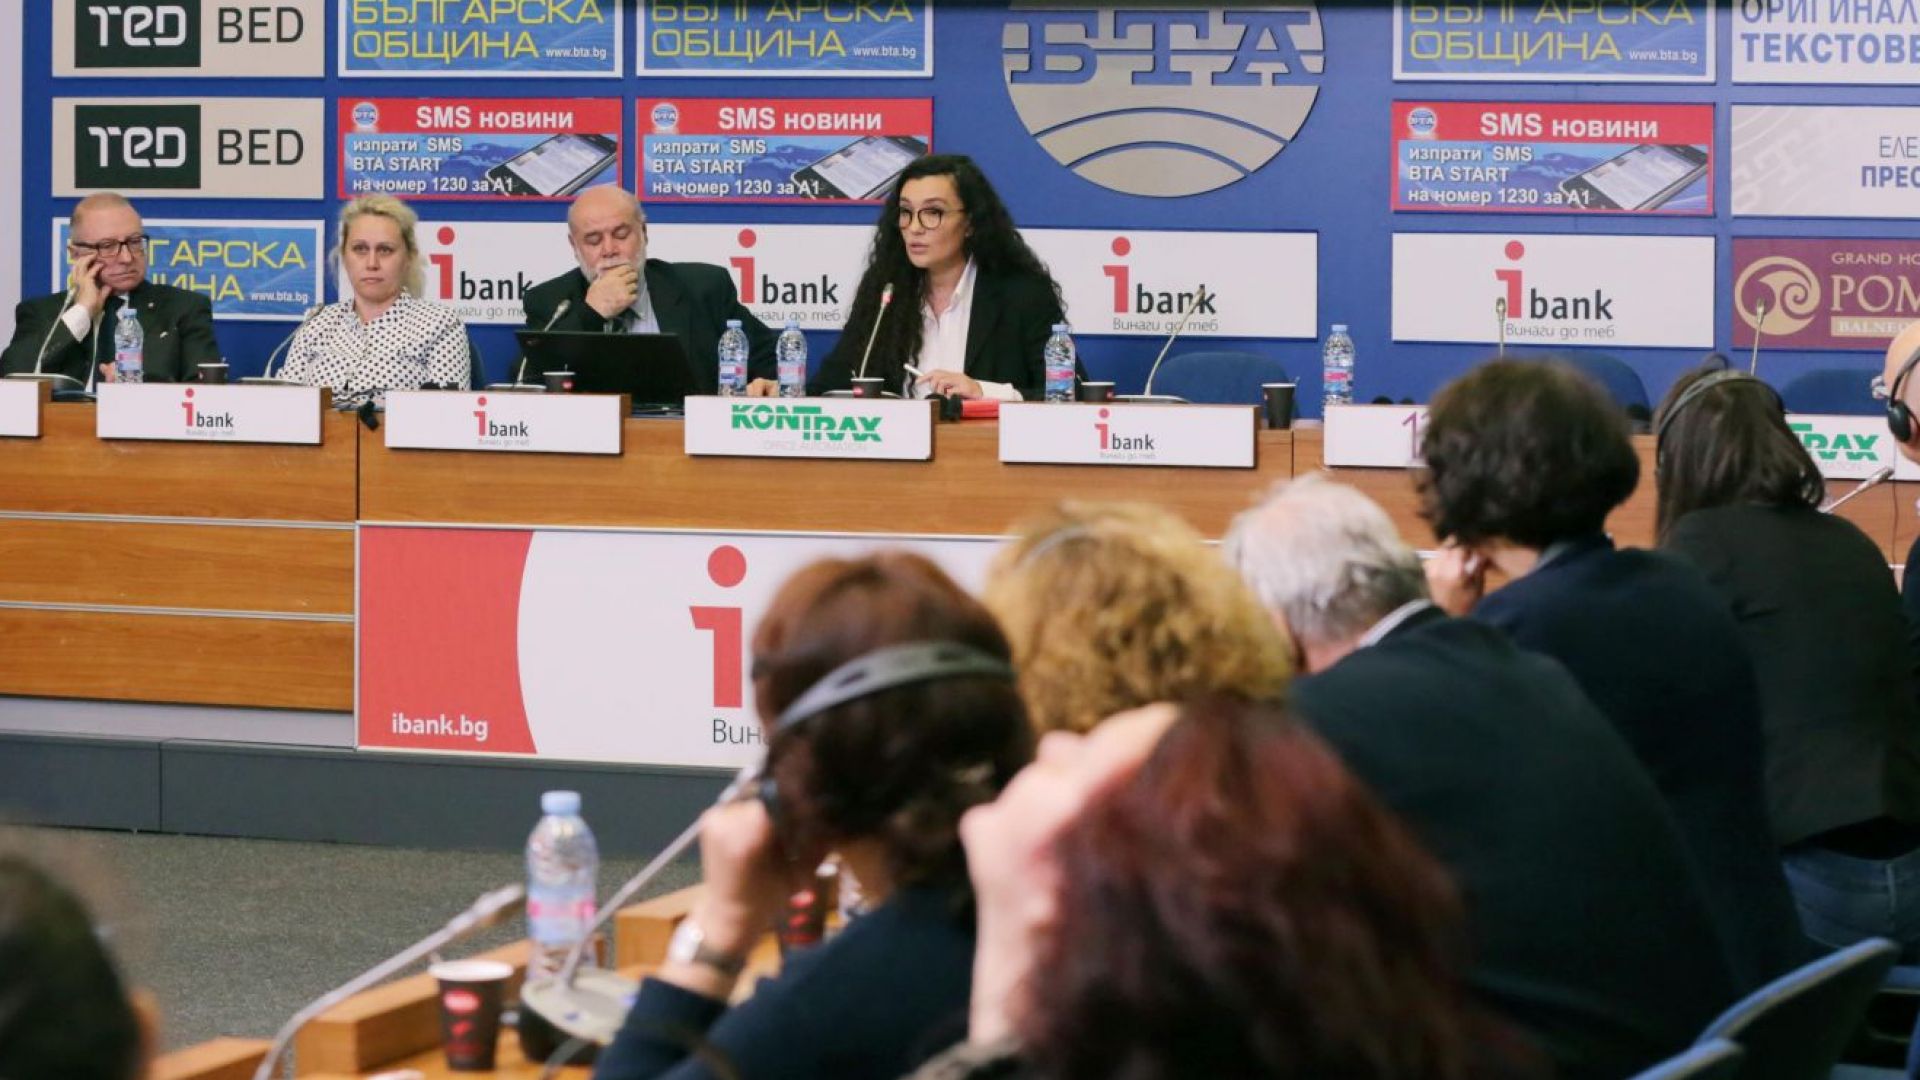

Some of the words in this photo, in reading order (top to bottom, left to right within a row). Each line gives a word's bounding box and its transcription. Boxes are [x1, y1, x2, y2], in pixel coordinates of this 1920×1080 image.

[353, 0, 604, 24] БЪЛГАРСКА
[1741, 0, 1918, 24] ОРИГИНАЛ
[217, 7, 304, 43] BED
[353, 30, 539, 64] ОБЩИНА
[545, 46, 607, 60] www.bta.bg
[652, 29, 847, 63] ОБЩИНА
[853, 46, 917, 59] www.bta.bg
[1008, 10, 1321, 86] БТА
[1410, 31, 1622, 65] ОБЩИНА
[1629, 49, 1698, 63] www.bta.bg
[416, 105, 471, 129] SMS
[479, 111, 573, 129] новини
[718, 107, 776, 130] SMS
[784, 112, 883, 131] новини
[1480, 111, 1542, 138] SMS
[1552, 119, 1658, 139] новини
[217, 129, 304, 165] BED
[353, 139, 418, 155] изпрати
[426, 137, 463, 152] SMS
[652, 141, 720, 156] изпрати
[729, 139, 766, 154] SMS
[1408, 148, 1482, 164] изпрати
[1492, 146, 1533, 162] SMS
[1879, 136, 1918, 158] ЕЛЕ
[389, 157, 443, 172] START
[690, 159, 745, 174] START
[1449, 166, 1510, 182] START
[353, 179, 371, 191] на
[376, 179, 427, 193] номер
[432, 177, 468, 192] 1230
[472, 179, 490, 192] за
[491, 177, 514, 192] A1
[653, 181, 672, 194] на
[676, 181, 730, 197] номер
[735, 180, 772, 194] 1230
[776, 182, 795, 195] за
[797, 180, 820, 195] A1
[1408, 189, 1429, 203] на
[1434, 190, 1492, 206] номер
[1497, 188, 1538, 204] 1230
[1543, 192, 1563, 205] за
[1566, 189, 1591, 205] A1
[1831, 252, 1892, 265] GRAND
[251, 291, 308, 304] www.bta.bg
[731, 404, 882, 442] KONTRAX
[391, 712, 488, 741] ibank.bg
